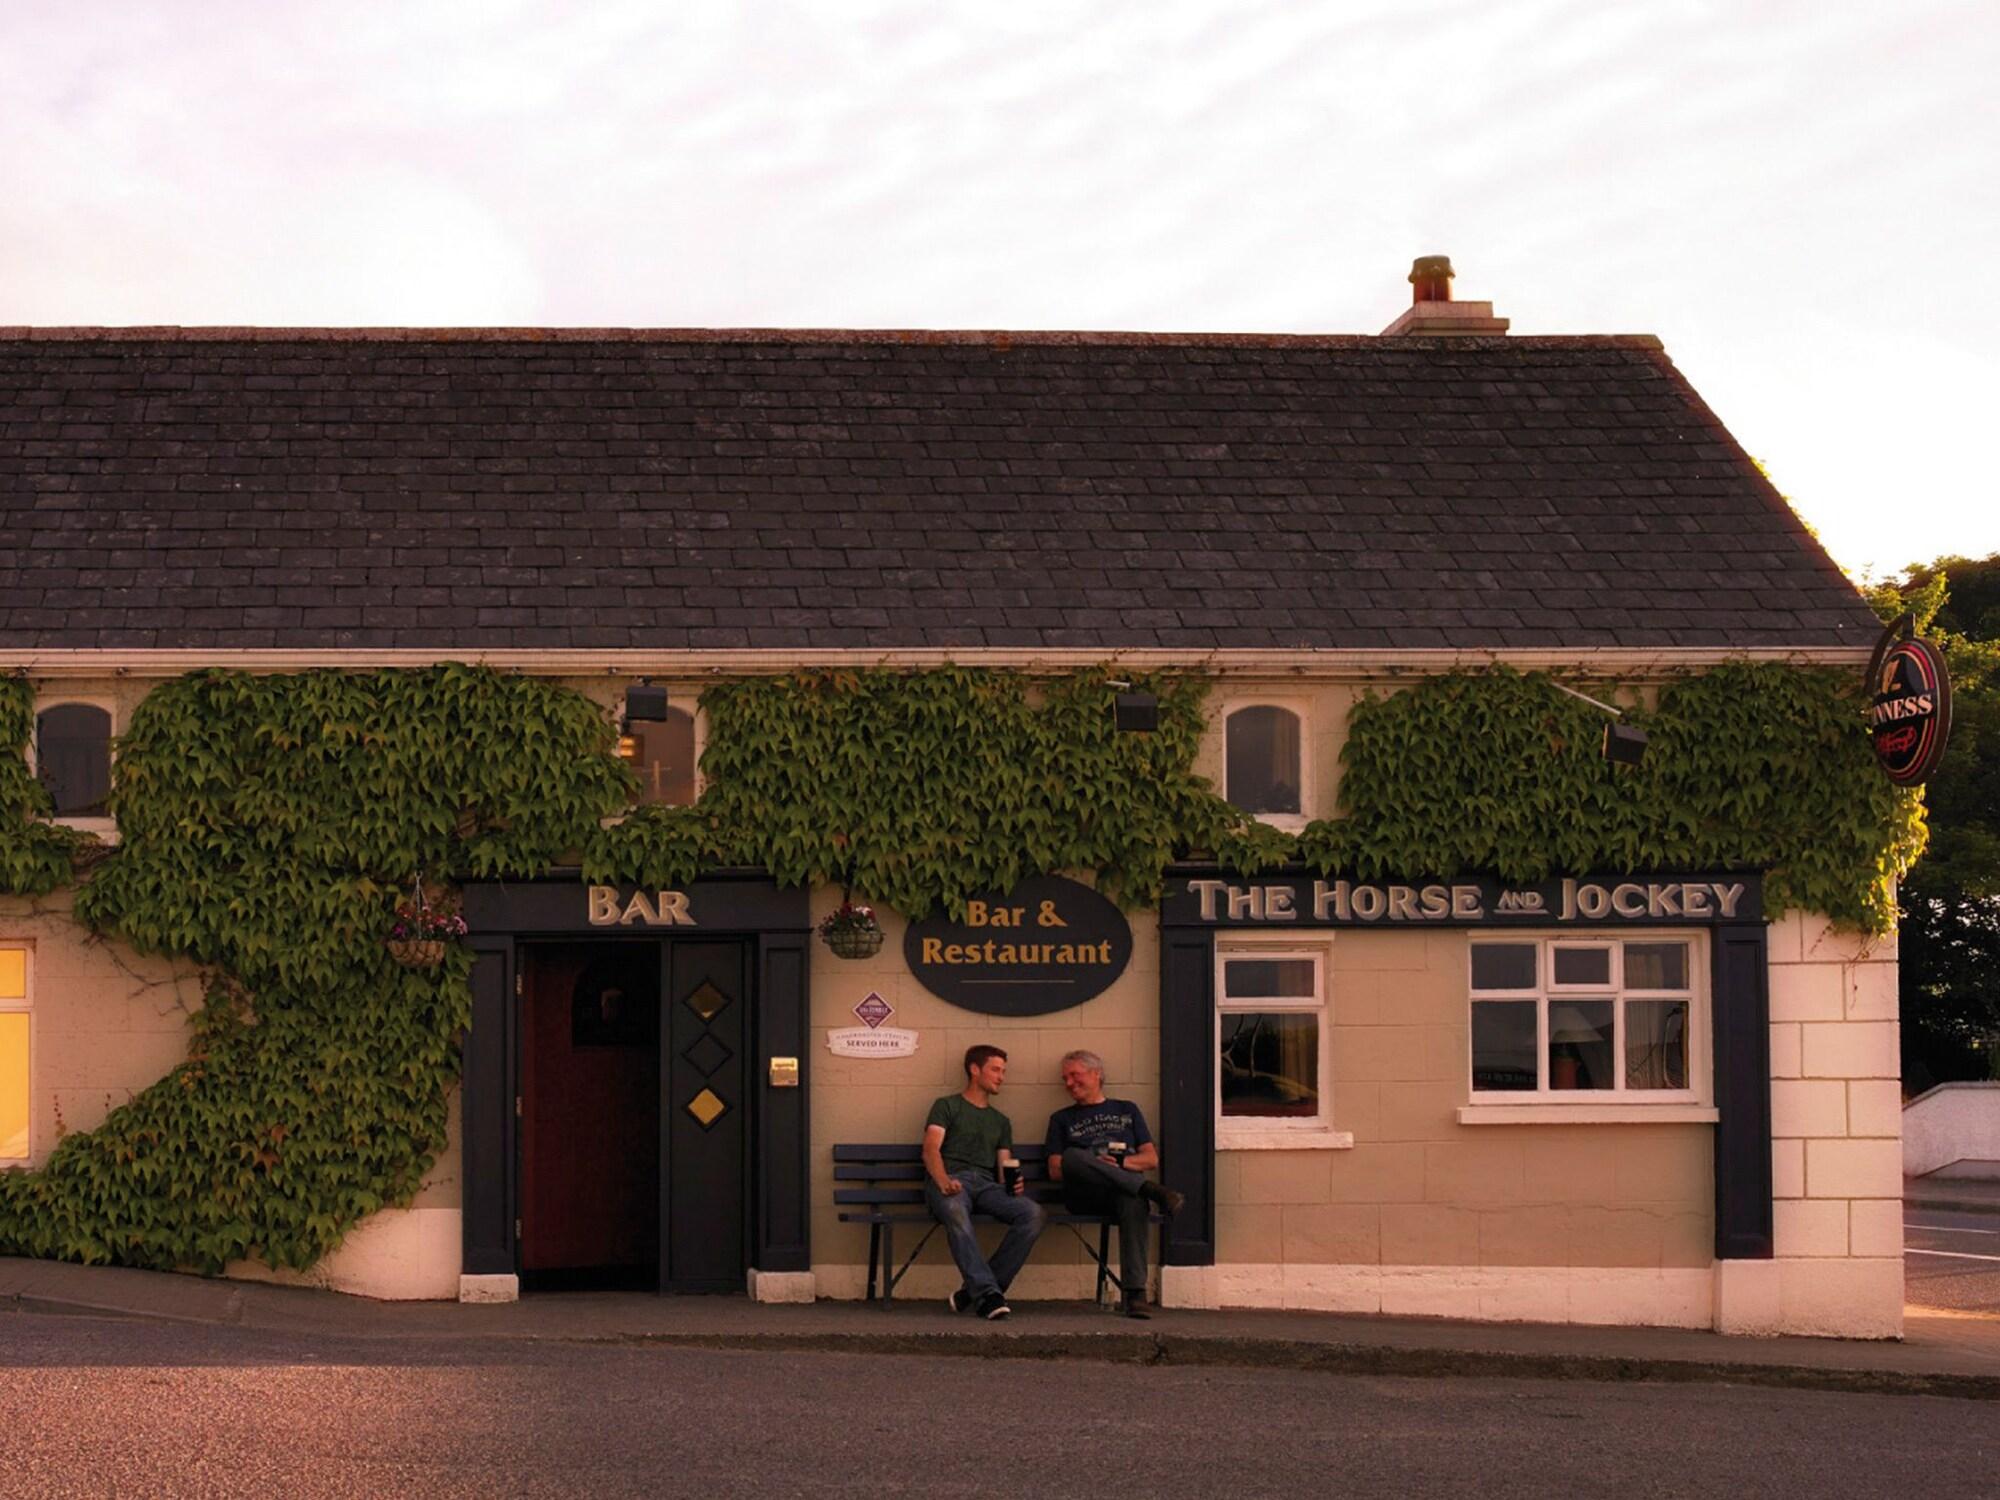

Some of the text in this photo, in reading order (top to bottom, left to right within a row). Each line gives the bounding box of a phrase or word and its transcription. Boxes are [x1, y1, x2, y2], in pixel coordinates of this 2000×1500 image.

[588, 885, 697, 925] BAR
[1187, 878, 1744, 921] THE HORSE AND JOCKEY
[967, 900, 1068, 927] Bar &
[922, 937, 1112, 964] Restaurant
[846, 1040, 900, 1048] SERVED HERE
